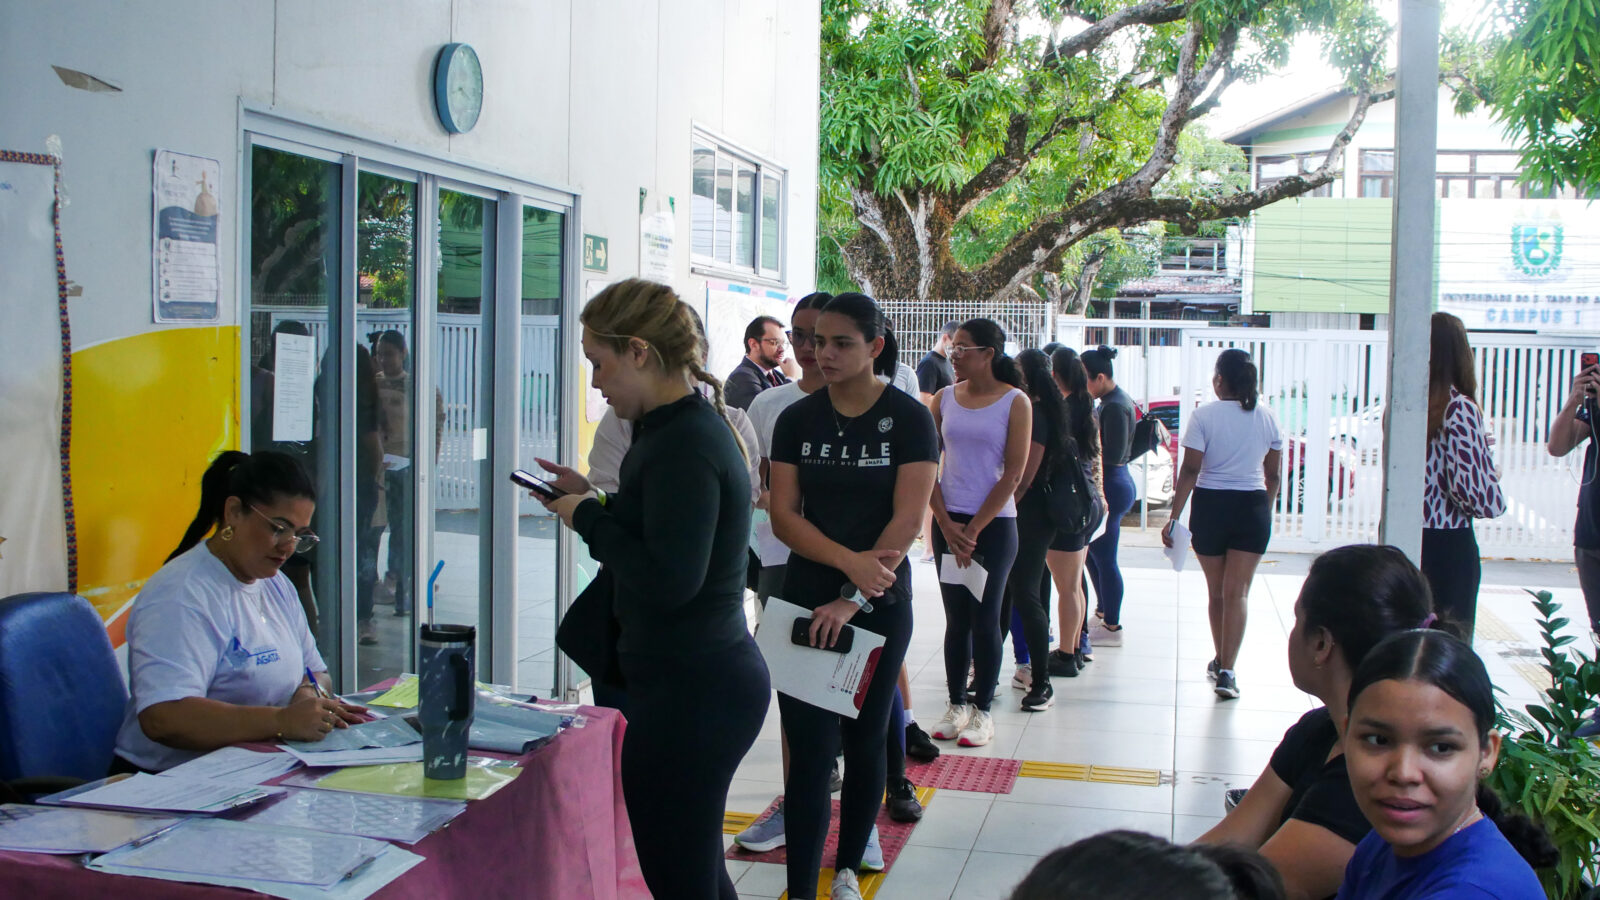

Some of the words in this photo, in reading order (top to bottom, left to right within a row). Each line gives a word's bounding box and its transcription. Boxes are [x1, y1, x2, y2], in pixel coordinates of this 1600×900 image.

[1486, 308, 1563, 324] CAMPUS
[1574, 310, 1582, 325] I
[801, 442, 890, 459] BELLE
